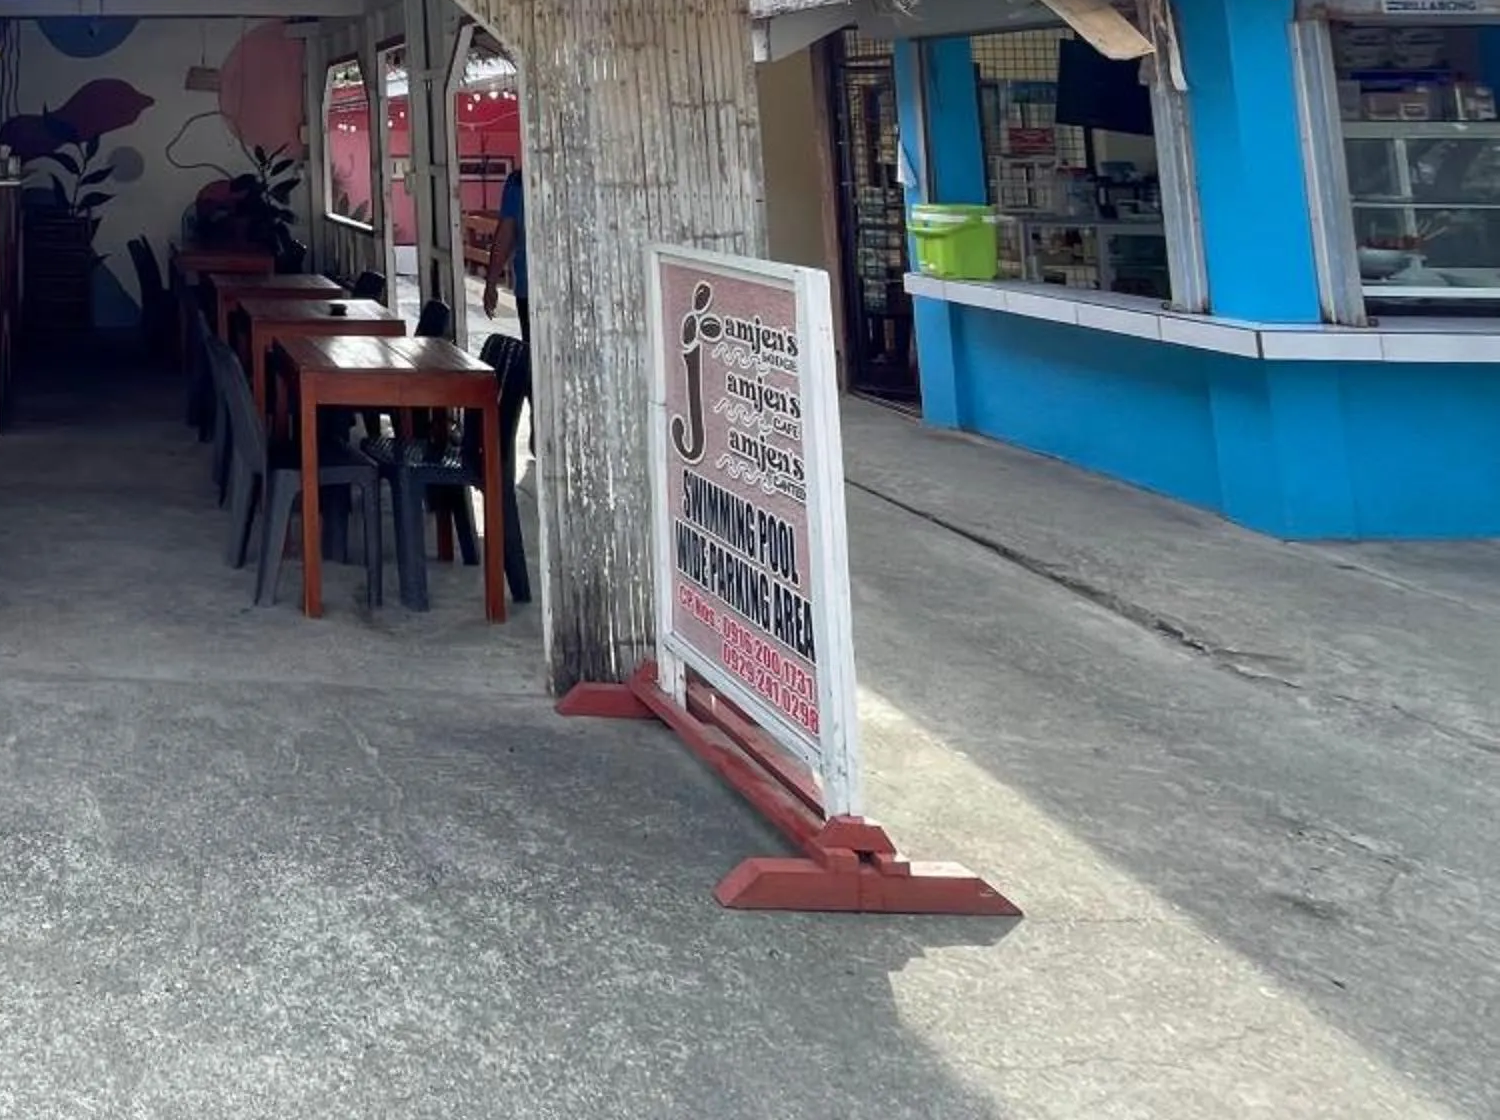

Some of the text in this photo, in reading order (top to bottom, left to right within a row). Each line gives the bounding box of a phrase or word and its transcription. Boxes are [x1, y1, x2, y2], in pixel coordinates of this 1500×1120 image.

[683, 469, 799, 585] SWIMMING POOL
[675, 519, 816, 664] WIDE PARKING AREA
[754, 639, 781, 675] 200
